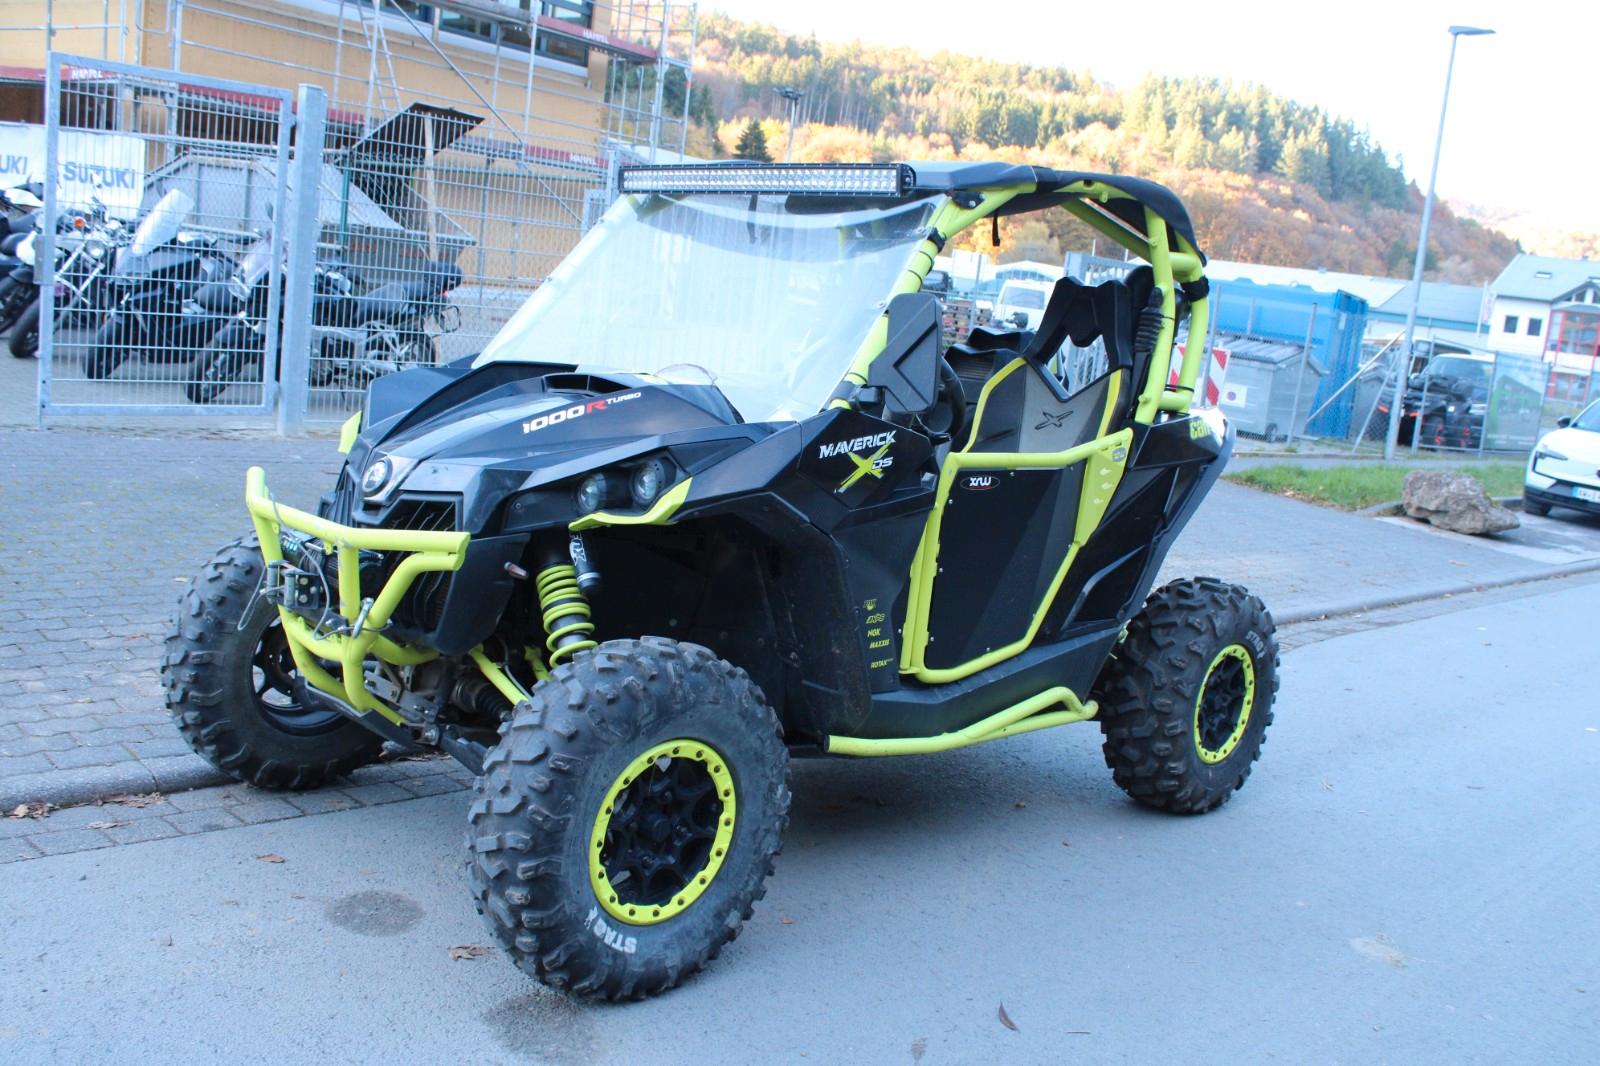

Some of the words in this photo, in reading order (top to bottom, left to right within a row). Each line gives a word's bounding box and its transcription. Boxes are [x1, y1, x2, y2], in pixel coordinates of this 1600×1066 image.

[522, 400, 608, 434] 1000R
[605, 391, 642, 405] TURBO
[819, 430, 897, 459] MAVERICK
